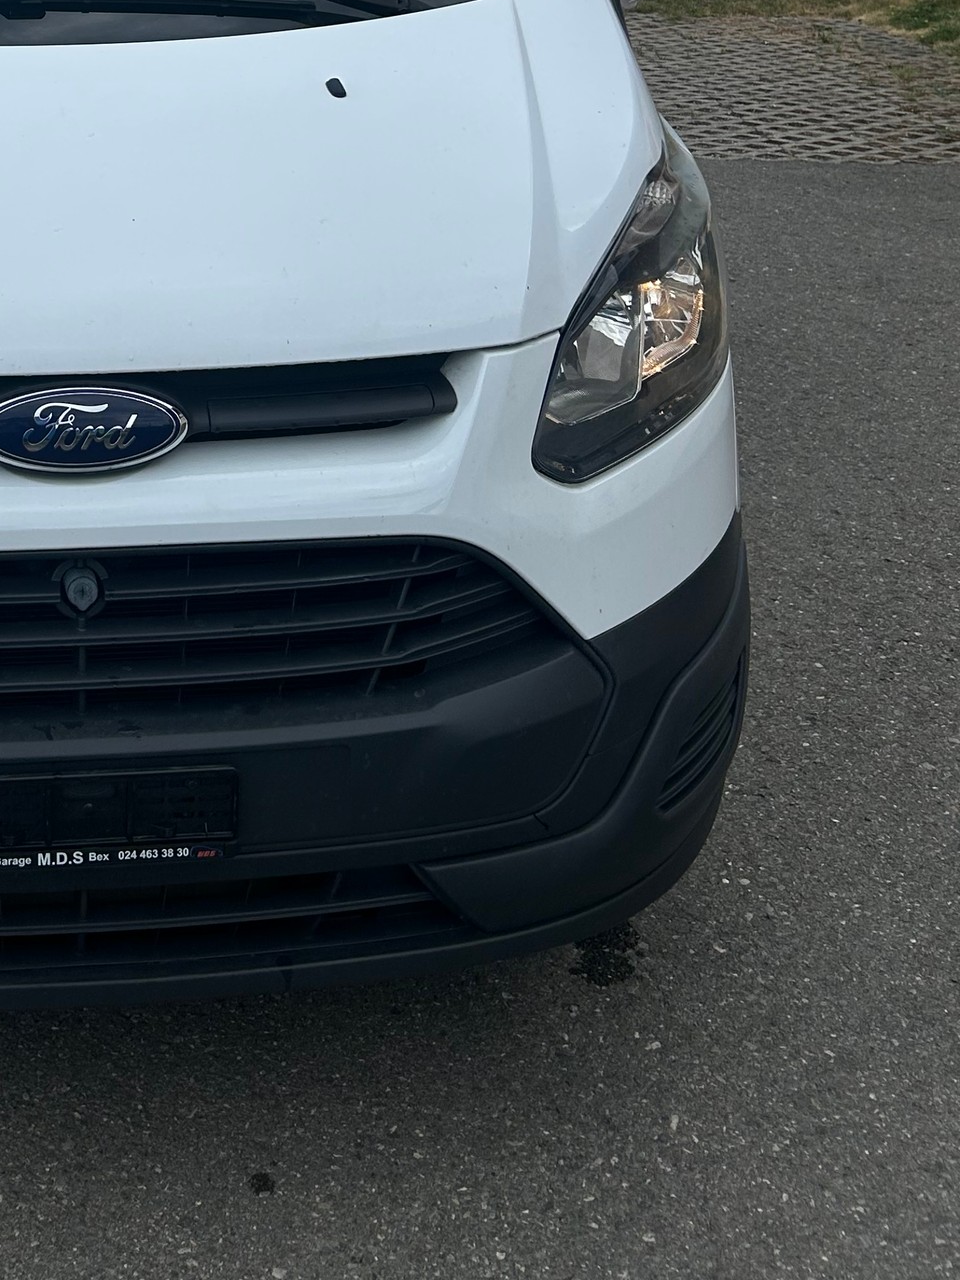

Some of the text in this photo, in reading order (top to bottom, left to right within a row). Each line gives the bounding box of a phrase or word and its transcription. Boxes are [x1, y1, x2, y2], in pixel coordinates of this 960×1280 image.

[22, 402, 138, 452] Ford
[37, 850, 84, 867] M.D.S
[117, 850, 138, 861] 024
[139, 848, 159, 860] 463
[161, 848, 174, 858] 38
[176, 847, 190, 858] 30
